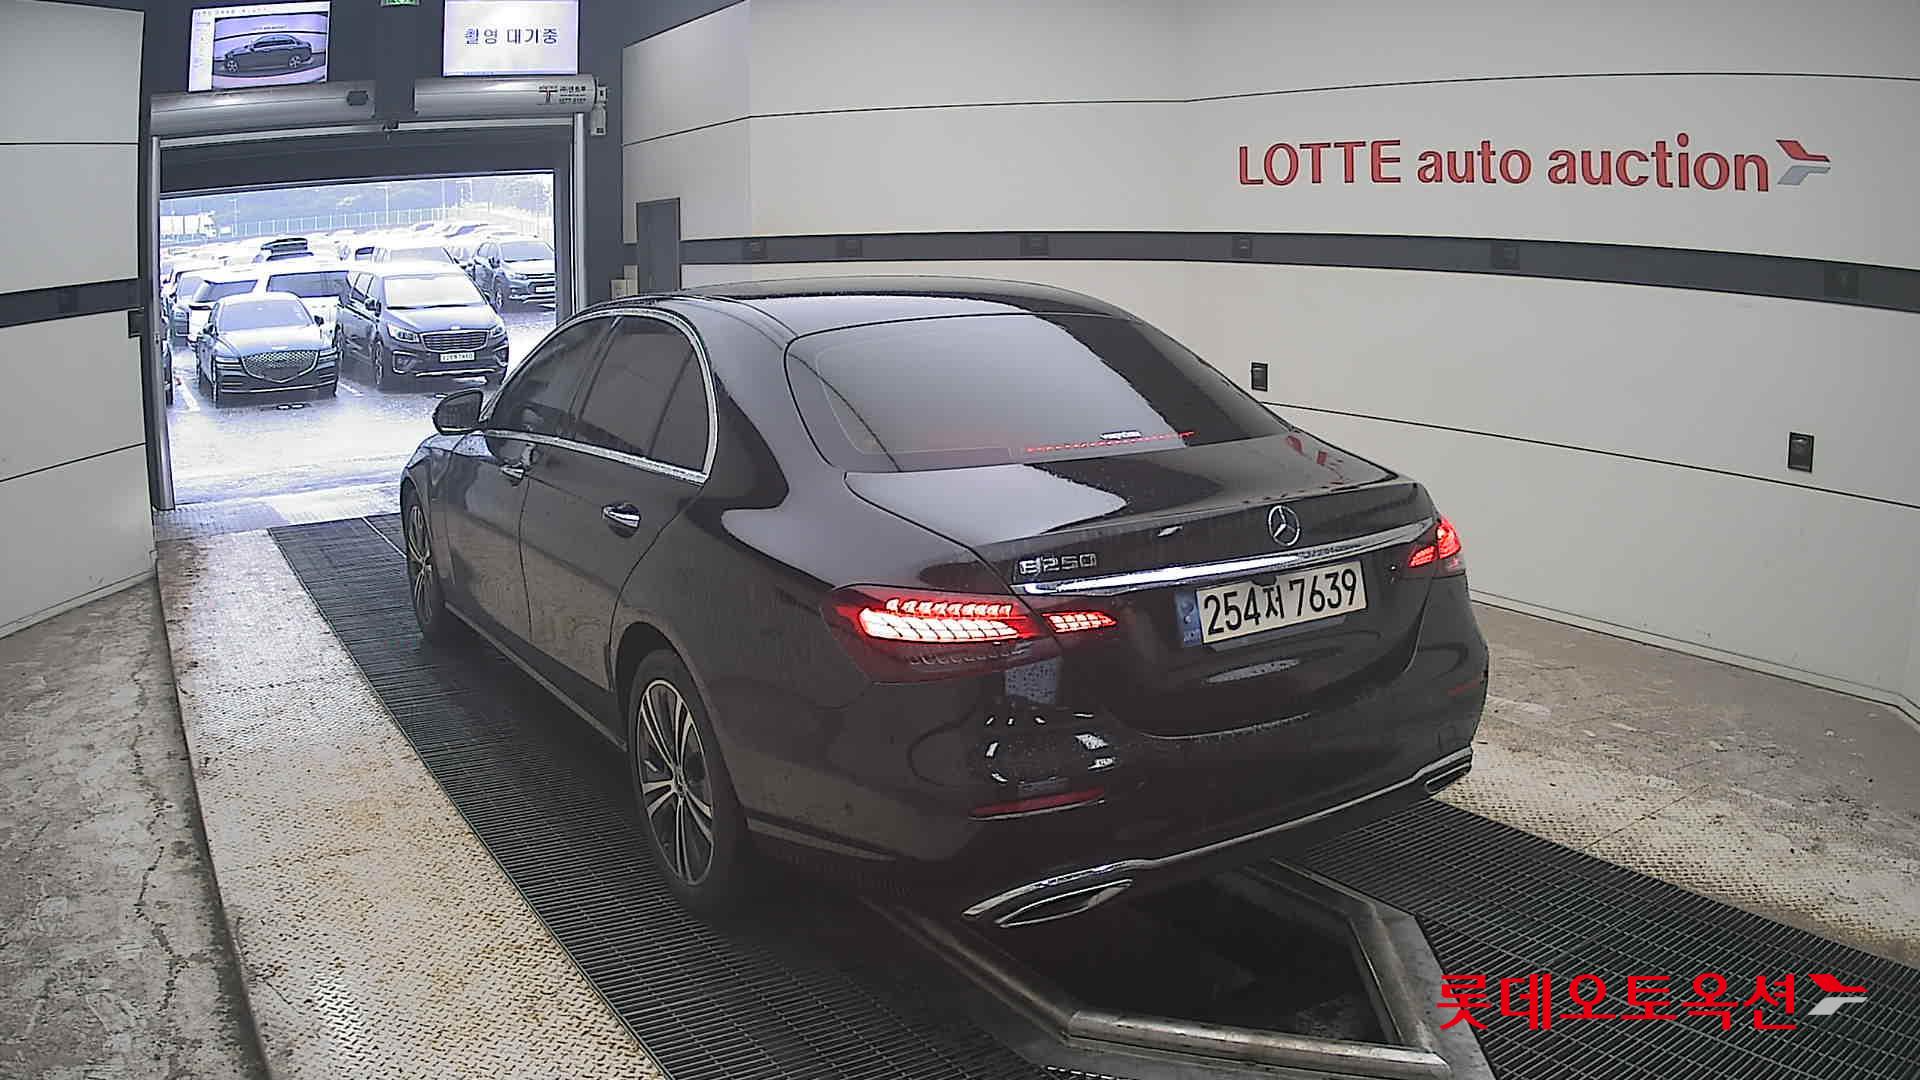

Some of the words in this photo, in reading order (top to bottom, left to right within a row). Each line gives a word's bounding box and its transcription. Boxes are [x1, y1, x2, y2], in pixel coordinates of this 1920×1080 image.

[506, 28, 558, 45] 대기중
[1239, 139, 1401, 186] LOTTE
[1417, 140, 1532, 185] auto
[1547, 132, 1769, 192] auction
[1288, 568, 1358, 618] 7639
